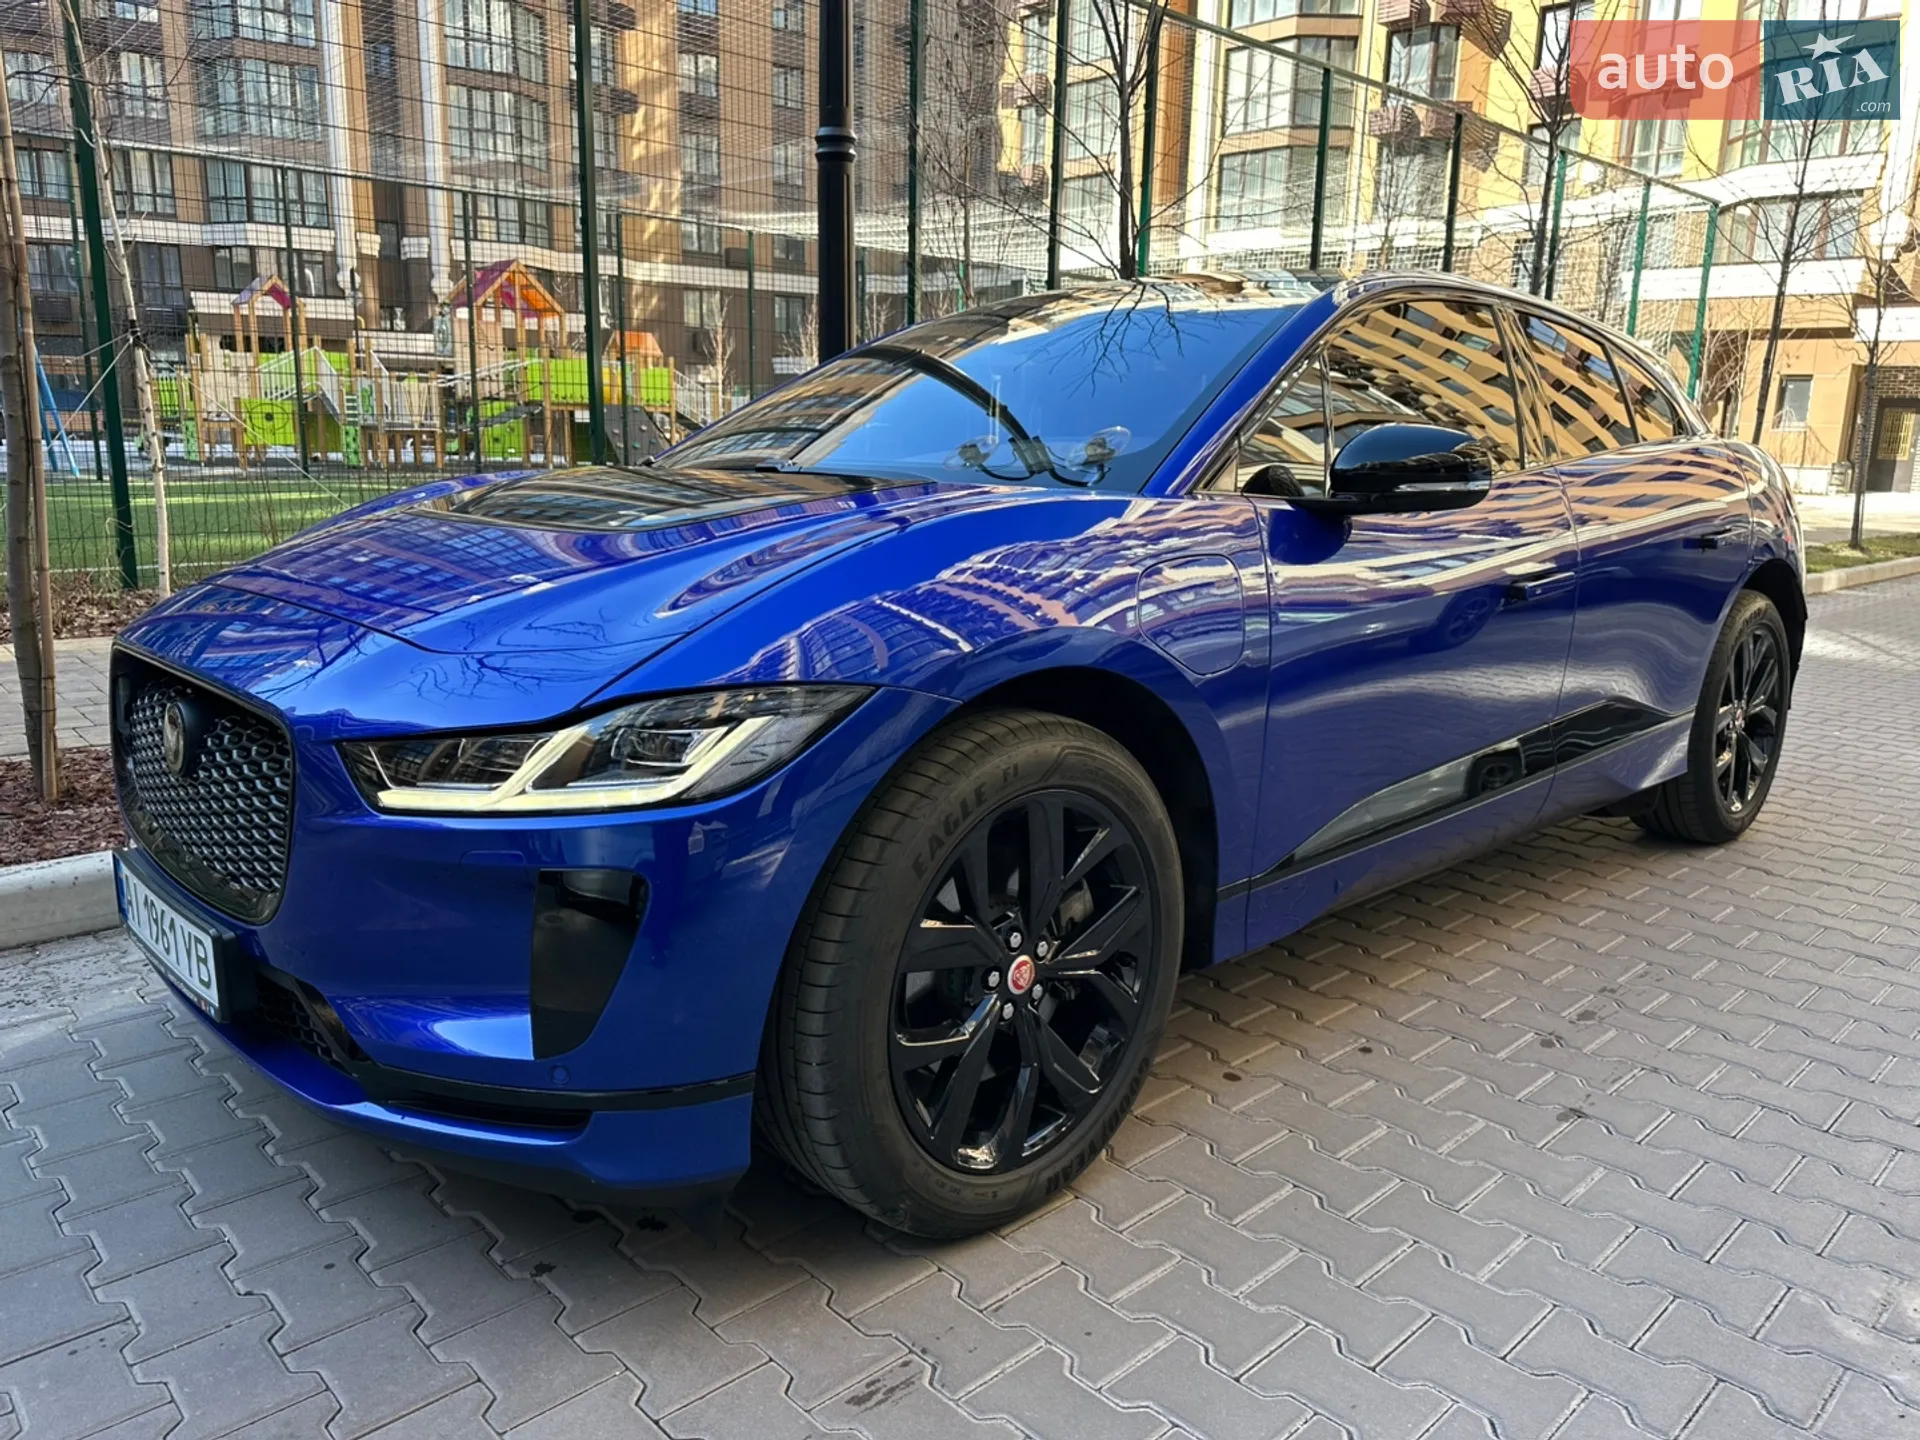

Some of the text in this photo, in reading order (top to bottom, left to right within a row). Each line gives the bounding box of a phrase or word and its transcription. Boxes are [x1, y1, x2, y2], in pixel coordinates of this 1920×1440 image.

[911, 782, 987, 880] EAGLE
[143, 893, 181, 967] 1961
[180, 924, 211, 989] YB
